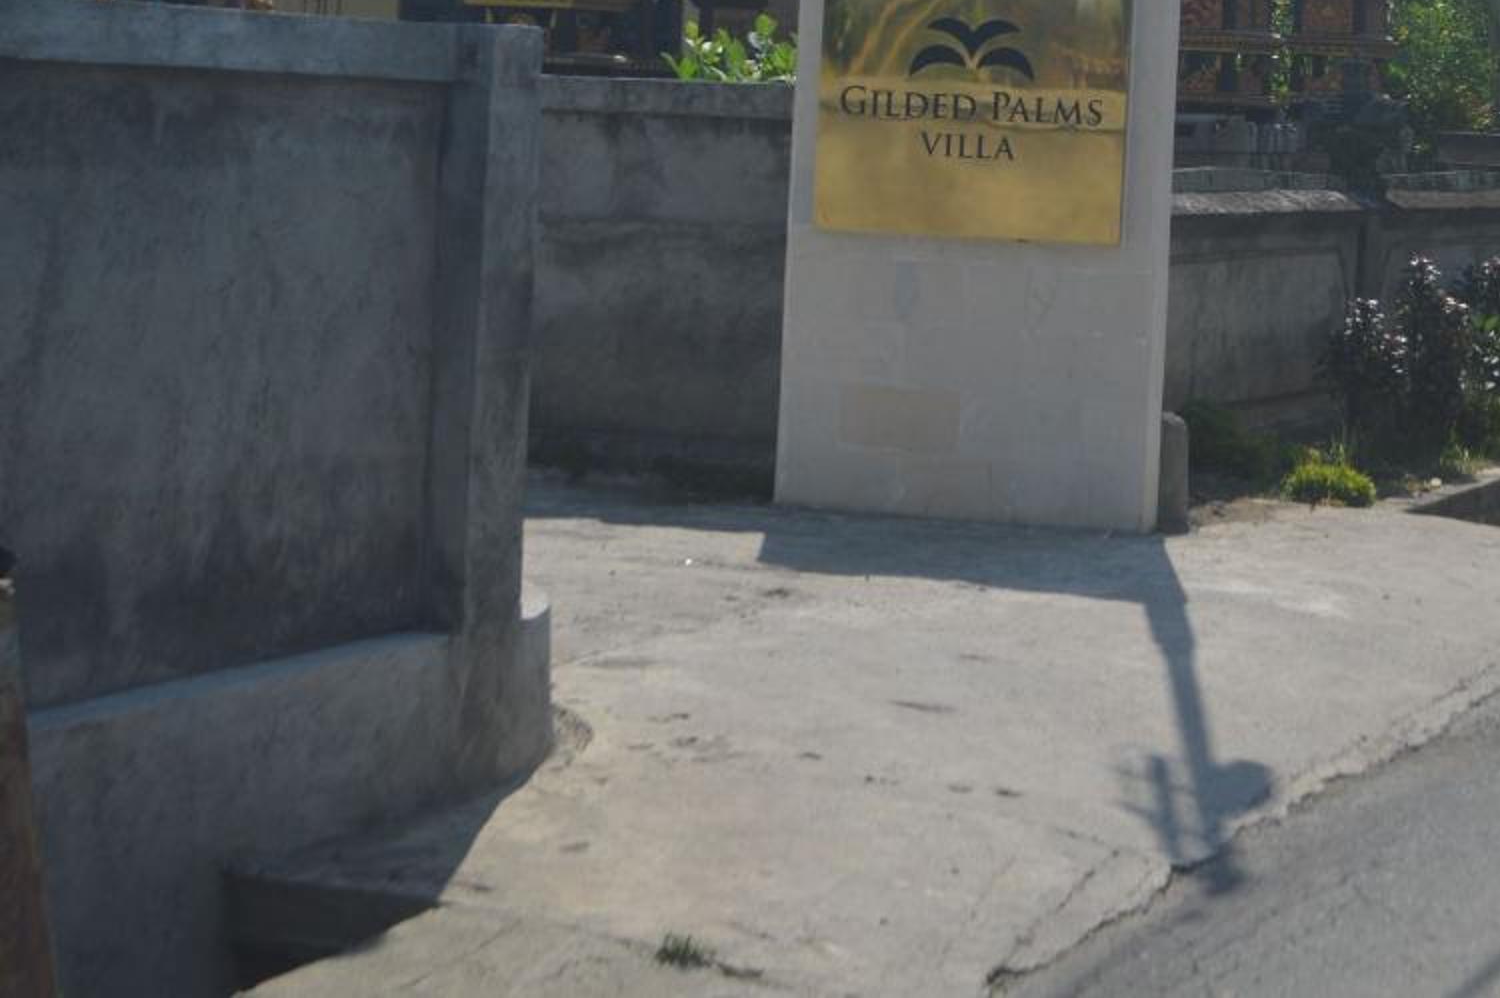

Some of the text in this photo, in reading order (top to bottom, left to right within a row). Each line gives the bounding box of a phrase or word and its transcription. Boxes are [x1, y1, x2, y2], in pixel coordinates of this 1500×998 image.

[839, 85, 1104, 127] GILDED PALMS
[921, 132, 1015, 161] VILLA
